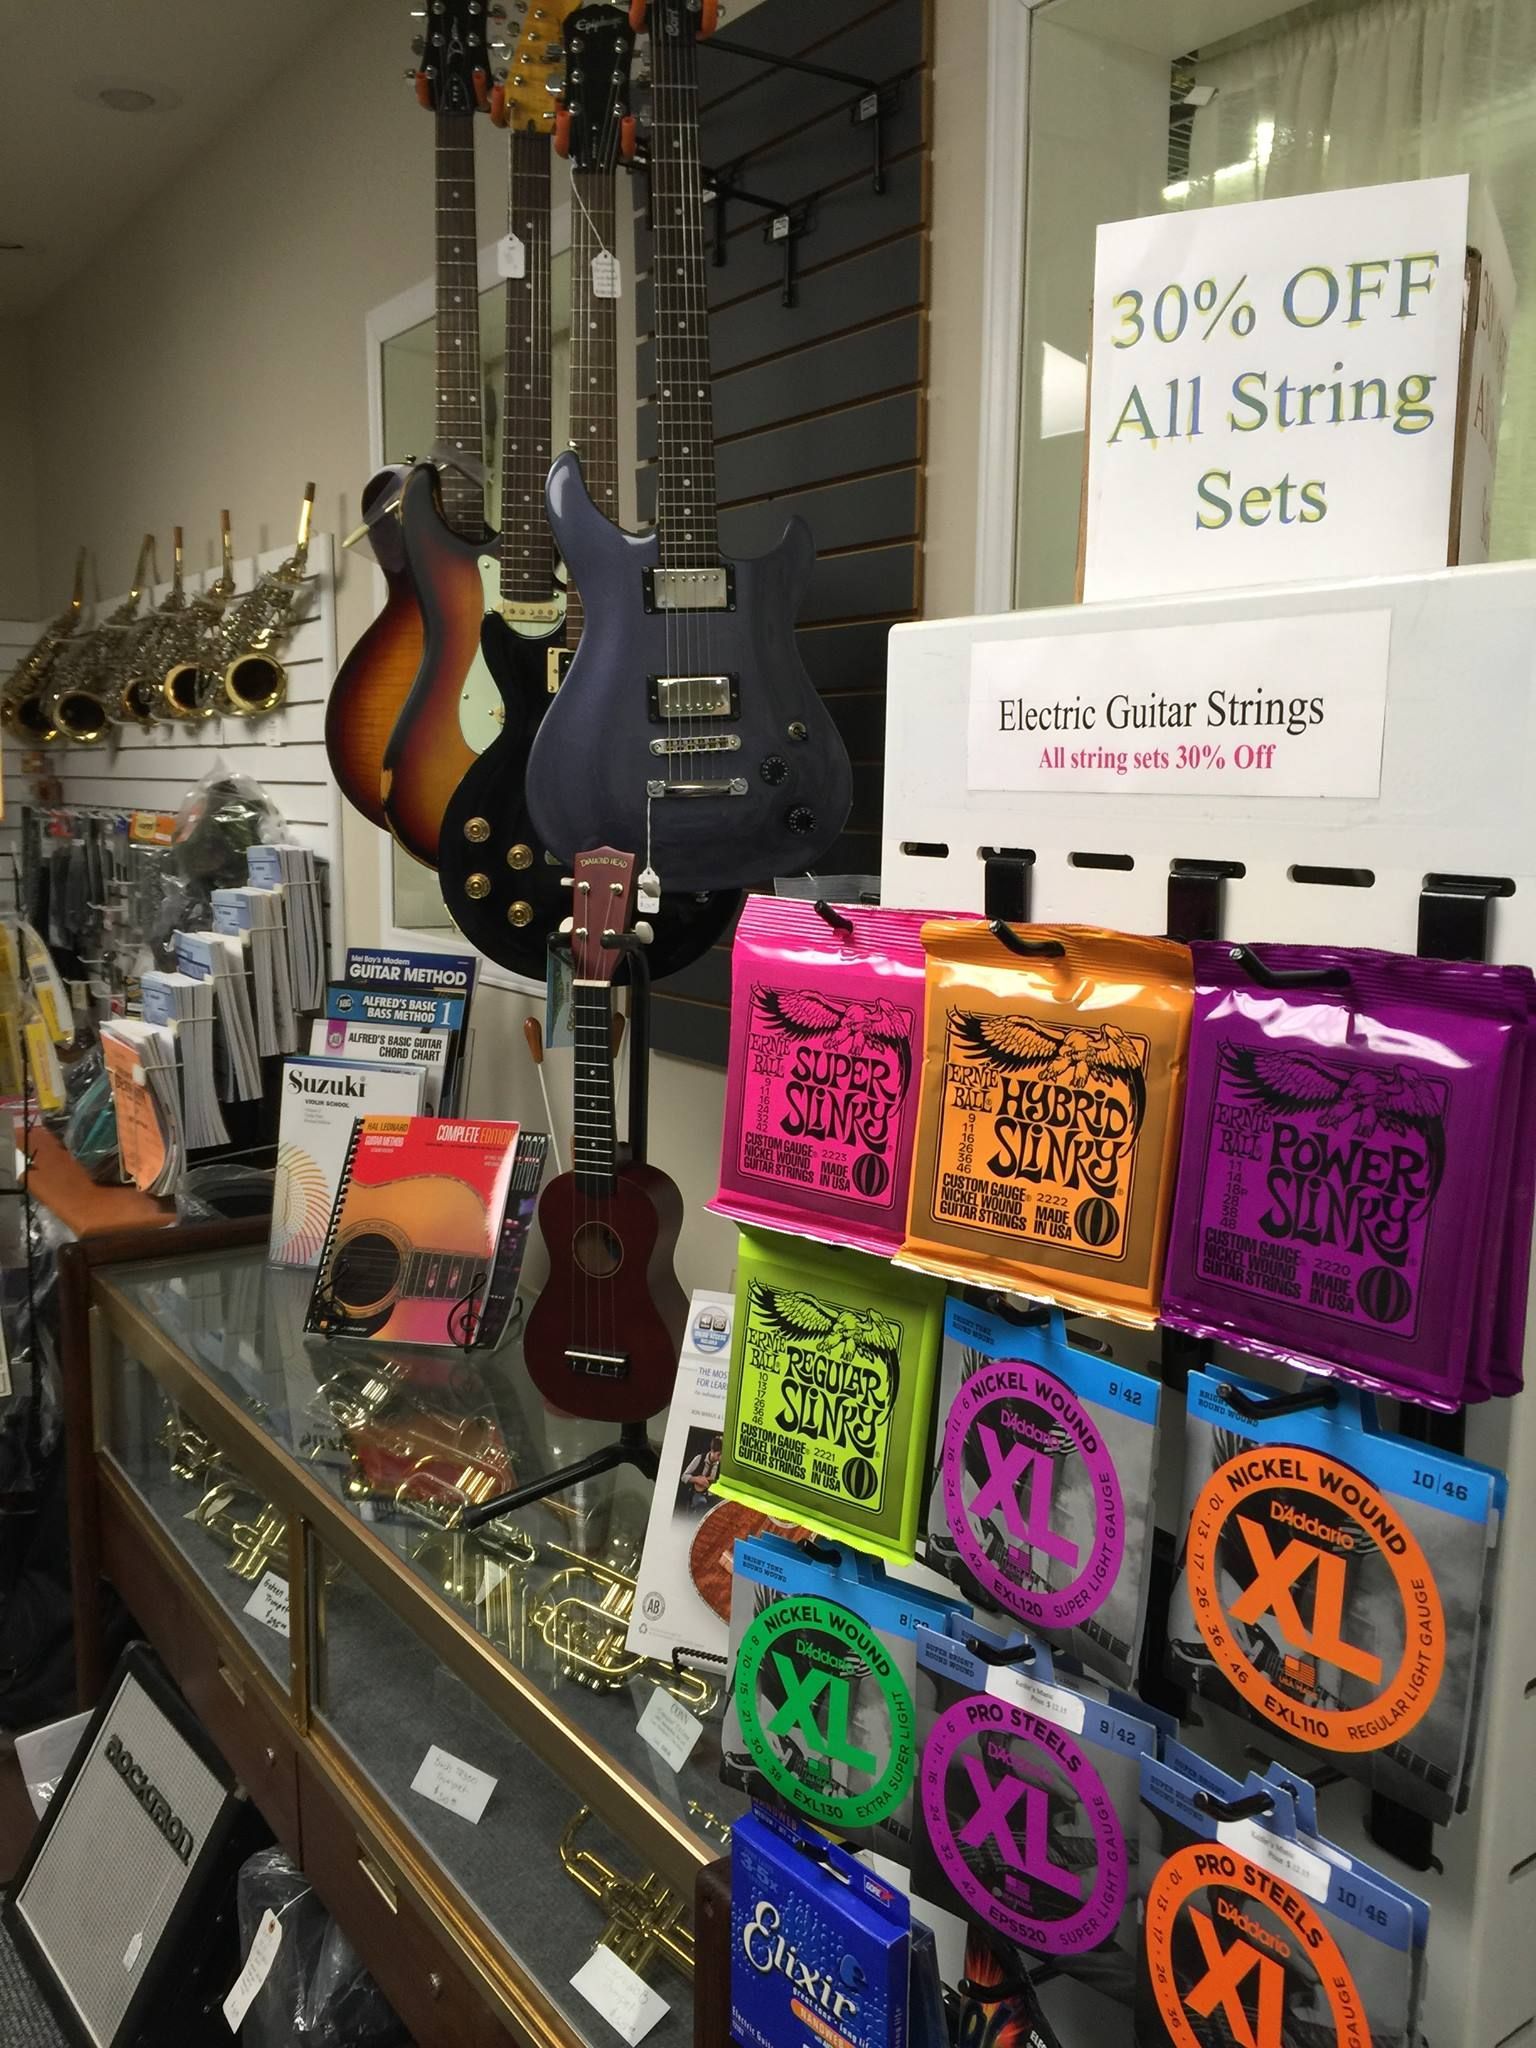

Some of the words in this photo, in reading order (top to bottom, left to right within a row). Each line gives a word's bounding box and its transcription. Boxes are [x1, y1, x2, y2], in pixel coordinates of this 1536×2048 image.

[1112, 275, 1257, 349] 30%
[1282, 252, 1440, 328] OFF
[1106, 376, 1204, 444] All
[1231, 362, 1437, 434] String
[1196, 471, 1327, 530] Sets
[999, 696, 1096, 731] Electric
[1106, 692, 1197, 729] Guitar
[1207, 687, 1324, 735] Strings
[1039, 746, 1065, 769] All
[1070, 746, 1128, 775] string
[1133, 747, 1170, 769] sets
[1176, 744, 1226, 769] 30%
[1234, 743, 1276, 769] Off
[610, 857, 628, 868] HEAD
[350, 963, 400, 980] GUITAR
[404, 967, 467, 986] METHOD
[362, 995, 407, 1009] ALFRED'S
[409, 1000, 437, 1012] BASIC
[367, 1007, 391, 1019] BASS
[394, 1010, 435, 1024] METHOD
[440, 1001, 451, 1026] 1
[348, 1033, 386, 1045] ALFRED'S
[387, 1034, 412, 1047] BASIC
[413, 1037, 443, 1050] GUITAR
[379, 1047, 408, 1060] CHORD
[411, 1049, 441, 1062] CHART
[750, 1032, 791, 1057] ERNIE
[752, 1053, 784, 1078] BALL
[790, 1046, 897, 1101] SUPER
[948, 1062, 998, 1089] ERNIE
[287, 1069, 366, 1098] Suzuki
[326, 1100, 350, 1109] SCHOOL
[952, 1087, 993, 1113] BALL
[996, 1076, 1128, 1139] HYBRID
[367, 1122, 378, 1131] HAL
[380, 1122, 409, 1132] LEONARD
[780, 1080, 895, 1154] SLINKY
[962, 1123, 974, 1133] 11
[968, 1113, 976, 1123] 9
[1215, 1102, 1272, 1134] ERNIE
[436, 1124, 481, 1143] COMPLETE
[745, 1132, 782, 1150] CUSTOM
[784, 1139, 814, 1157] GAUGE
[958, 1143, 974, 1153] 26
[961, 1133, 975, 1143] 16
[1218, 1128, 1262, 1162] BALL
[743, 1157, 774, 1172] GUITAR
[775, 1164, 814, 1183] STRINGS
[744, 1143, 775, 1162] NICKEL
[776, 1150, 810, 1170] WOUND
[822, 1150, 847, 1162] 2223
[956, 1163, 972, 1174] 46
[957, 1153, 973, 1164] 36
[986, 1116, 1127, 1199] SLINKY
[1270, 1121, 1426, 1199] POWER
[941, 1186, 979, 1208] NICKEL
[981, 1193, 1023, 1216] WOUND
[942, 1173, 989, 1194] CUSTOM
[990, 1181, 1027, 1201] GAUGE
[1036, 1192, 1068, 1207] 2222
[939, 1200, 977, 1221] GUITAR
[978, 1209, 1027, 1232] STRINGS
[1035, 1205, 1070, 1225] MADE
[1258, 1167, 1420, 1267] SLINKY
[1033, 1220, 1046, 1234] IN
[1049, 1223, 1072, 1241] USA
[747, 1327, 787, 1354] ERNIE
[699, 1367, 710, 1377] THE
[712, 1370, 728, 1379] MOS
[749, 1347, 781, 1375] BALL
[696, 1378, 709, 1388] FOR
[784, 1346, 885, 1410] REGULAR
[1108, 1381, 1118, 1396] 9
[1122, 1389, 1142, 1406] 42
[775, 1378, 884, 1459] SLINKY
[970, 1371, 1029, 1403] NICKEL
[1035, 1379, 1098, 1454] WOUND
[740, 1434, 768, 1455] NICKEL
[771, 1443, 803, 1466] WOUND
[741, 1422, 777, 1443] CUSTOM
[778, 1434, 807, 1455] GAUGE
[738, 1445, 767, 1466] GUITAR
[768, 1456, 806, 1480] STRINGS
[812, 1459, 839, 1479] MADE
[810, 1470, 820, 1485] IN
[822, 1474, 841, 1493] USA
[967, 1421, 1080, 1569] XL
[1412, 1469, 1435, 1489] 10
[1442, 1480, 1468, 1501] 46
[1099, 1472, 1116, 1540] GAUGE
[1208, 1492, 1224, 1511] 10
[1225, 1458, 1309, 1492] NICKEL
[1317, 1466, 1407, 1556] WOUND
[1197, 1519, 1211, 1540] 13
[1270, 1500, 1355, 1550] D'Addario
[1088, 1546, 1112, 1592] LIGHT
[1194, 1550, 1205, 1572] 17
[647, 1599, 660, 1614] AB
[993, 1579, 1043, 1618] EXL120
[1053, 1589, 1091, 1618] SUPER
[1195, 1585, 1210, 1609] 26
[1227, 1513, 1383, 1687] XL
[1411, 1577, 1433, 1646] GAUGE
[899, 1613, 908, 1626] 8
[763, 1605, 823, 1634] NICKEL
[828, 1611, 890, 1677] WOUND
[1208, 1625, 1225, 1648] 36
[1230, 1661, 1249, 1684] 46
[1407, 1650, 1432, 1702] LIGHT
[767, 1651, 877, 1776] XL
[891, 1691, 909, 1740] LIGHT
[1264, 1693, 1329, 1738] EXL110
[1347, 1699, 1410, 1741] REGULAR
[966, 1703, 1004, 1725] PRO
[1010, 1707, 1082, 1773] STEELS
[1099, 1720, 1109, 1734] 9
[1116, 1728, 1136, 1746] 42
[888, 1745, 910, 1791] SUPER
[105, 1734, 194, 1866] ROCKTRON
[793, 1788, 843, 1819] EXL130
[856, 1790, 892, 1818] EXTRA
[956, 1753, 1083, 1899] XL
[1194, 1854, 1236, 1877] PRO
[1243, 1864, 1324, 1949] STEELS
[1337, 1886, 1357, 1908] 10
[1364, 1904, 1388, 1927] 46
[988, 1905, 1047, 1944] EPS520
[1217, 1897, 1290, 1958] D'Addario
[743, 1900, 857, 2020] Elixir
[732, 2006, 756, 2036] Electric
[792, 1987, 813, 2008] great
[814, 2001, 831, 2022] tone
[839, 2023, 857, 2045] long
[1333, 1976, 1362, 2048] GAUGE
[800, 2008, 844, 2047] NANOWEB
